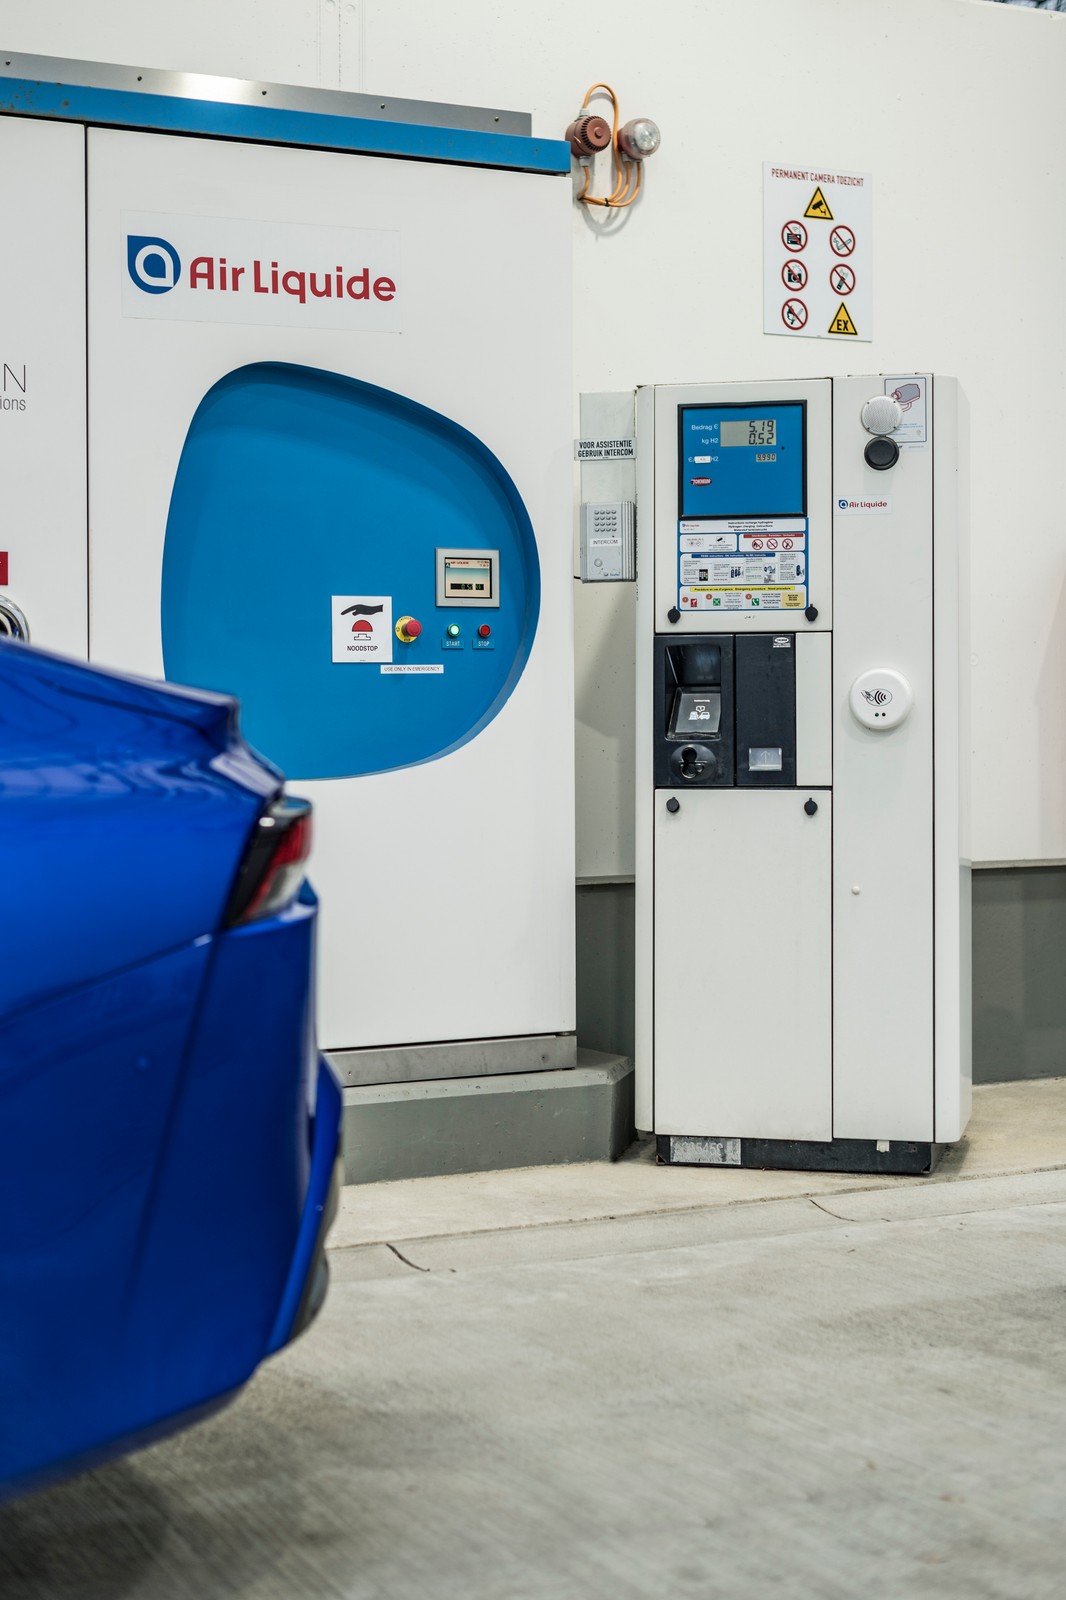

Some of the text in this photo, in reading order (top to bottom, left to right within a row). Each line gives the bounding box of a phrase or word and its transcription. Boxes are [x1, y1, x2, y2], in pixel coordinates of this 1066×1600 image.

[771, 168, 864, 187] PERMANENT CAMERA TOEZICHT
[189, 256, 397, 304] Air Liquide
[836, 319, 849, 332] EX
[579, 439, 632, 449] VOOR ASSISTENTIE
[577, 448, 634, 458] GEBRUIK INTERCOM
[860, 501, 888, 509] Liquide
